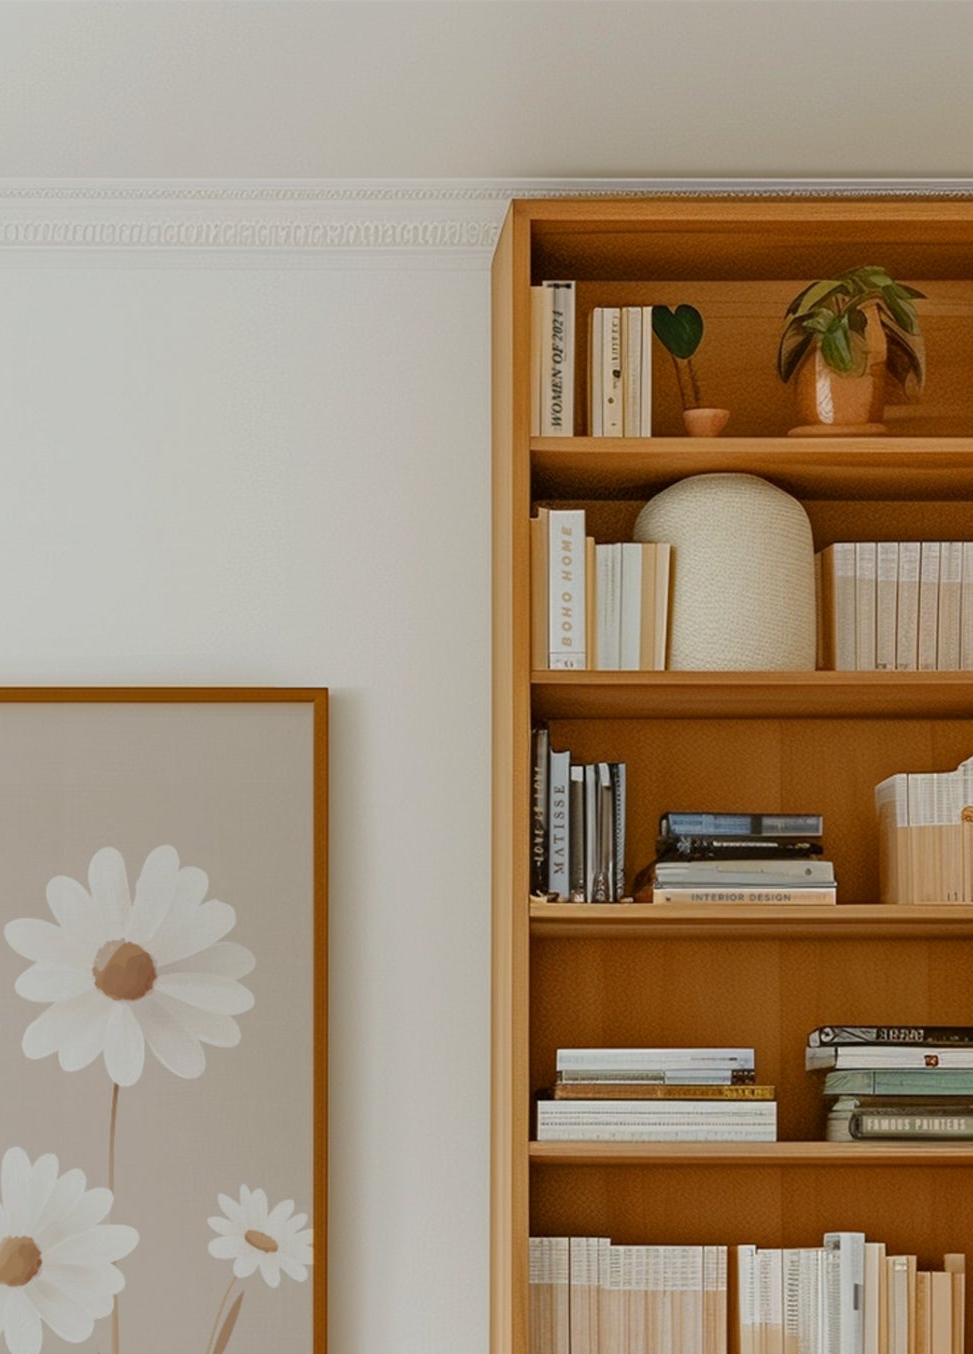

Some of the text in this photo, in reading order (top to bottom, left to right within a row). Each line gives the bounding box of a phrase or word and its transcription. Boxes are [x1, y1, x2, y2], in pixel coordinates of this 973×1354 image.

[551, 310, 563, 428] WOMEN OF 2024
[561, 526, 573, 647] BOHO HOME
[534, 829, 544, 862] LOVE
[553, 784, 566, 875] MATISSE
[691, 893, 791, 902] INTERIOR DESIGN
[867, 1118, 966, 1130] FAMOUS PAINTERS
